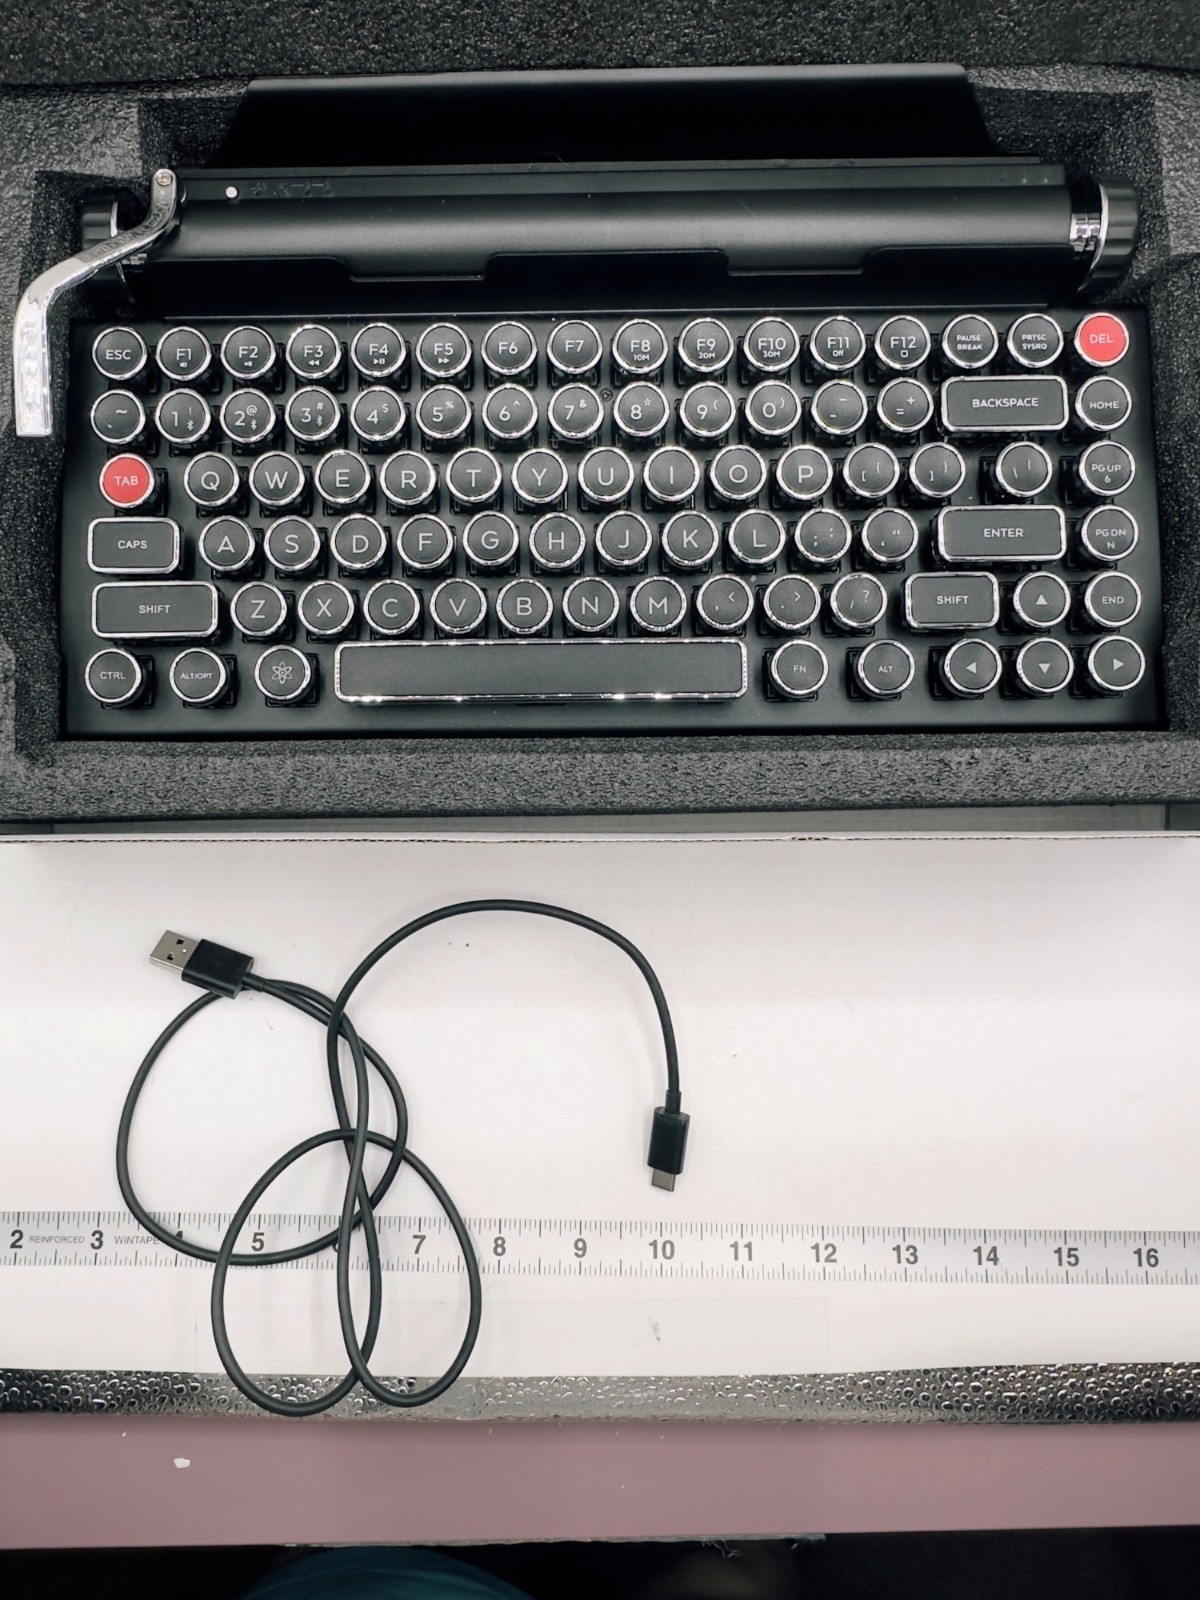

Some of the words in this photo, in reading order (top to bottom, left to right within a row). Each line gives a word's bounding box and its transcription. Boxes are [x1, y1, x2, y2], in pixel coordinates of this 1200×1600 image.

[697, 338, 715, 350] F9
[759, 337, 786, 350] F10
[828, 337, 849, 348] F11
[891, 337, 916, 348] F12
[1089, 333, 1115, 344] DEL
[239, 346, 257, 358] F2
[304, 345, 323, 357] F3
[369, 343, 388, 355] F4
[435, 343, 453, 355] F5
[499, 342, 517, 354] F6
[565, 340, 584, 352] F7
[631, 340, 650, 352] F8
[104, 349, 132, 361] ESC
[177, 348, 191, 360] F1
[972, 397, 1039, 408] BACKSPACE
[1089, 400, 1120, 410] HOME
[301, 408, 311, 422] 3
[367, 410, 378, 423] 4
[433, 407, 443, 421] 5
[500, 406, 510, 420] 6
[565, 405, 574, 419] 7
[631, 404, 641, 419] 8
[697, 404, 708, 419] 9
[763, 403, 775, 417] 0
[171, 410, 179, 427] 1
[235, 411, 245, 425] 2
[729, 465, 748, 483] O
[798, 465, 813, 483] P
[1091, 463, 1105, 473] PG
[113, 475, 139, 487] TAB
[201, 471, 219, 490] Q
[265, 471, 288, 489] W
[336, 469, 350, 487] E
[401, 470, 416, 488] R
[466, 469, 481, 487] T
[532, 468, 547, 486] Y
[598, 468, 613, 485] U
[1104, 474, 1111, 484] 6
[619, 530, 629, 548] J
[683, 530, 698, 547] K
[753, 529, 766, 547] L
[983, 527, 1024, 538] ENTER
[1095, 528, 1109, 538] PG
[1110, 528, 1127, 538] DN
[117, 539, 148, 550] CAPS
[218, 536, 234, 552] A
[285, 534, 299, 553] S
[353, 535, 368, 553] D
[419, 533, 433, 550] F
[482, 531, 499, 549] G
[549, 532, 564, 550] H
[517, 597, 532, 615] B
[582, 597, 598, 614] N
[649, 597, 667, 614] M
[936, 595, 969, 605] SHIFT
[1101, 595, 1125, 605] END
[138, 604, 171, 614] SHIFT
[251, 600, 265, 618] Z
[317, 599, 331, 617] X
[382, 599, 398, 617] C
[449, 599, 466, 616] V
[99, 670, 126, 680] CTRL
[10, 1230, 23, 1248] 2
[28, 1235, 86, 1244] REINFORCED
[91, 1230, 103, 1250] 3
[252, 1232, 264, 1251] 5
[413, 1235, 426, 1254] 7
[493, 1237, 506, 1256] 8
[574, 1238, 587, 1258] 9
[649, 1240, 674, 1259] 10
[730, 1241, 752, 1261] 11
[811, 1243, 837, 1263] 12
[893, 1245, 918, 1264] 13
[973, 1246, 999, 1265] 14
[1054, 1247, 1079, 1266] 15
[1134, 1248, 1158, 1267] 16
